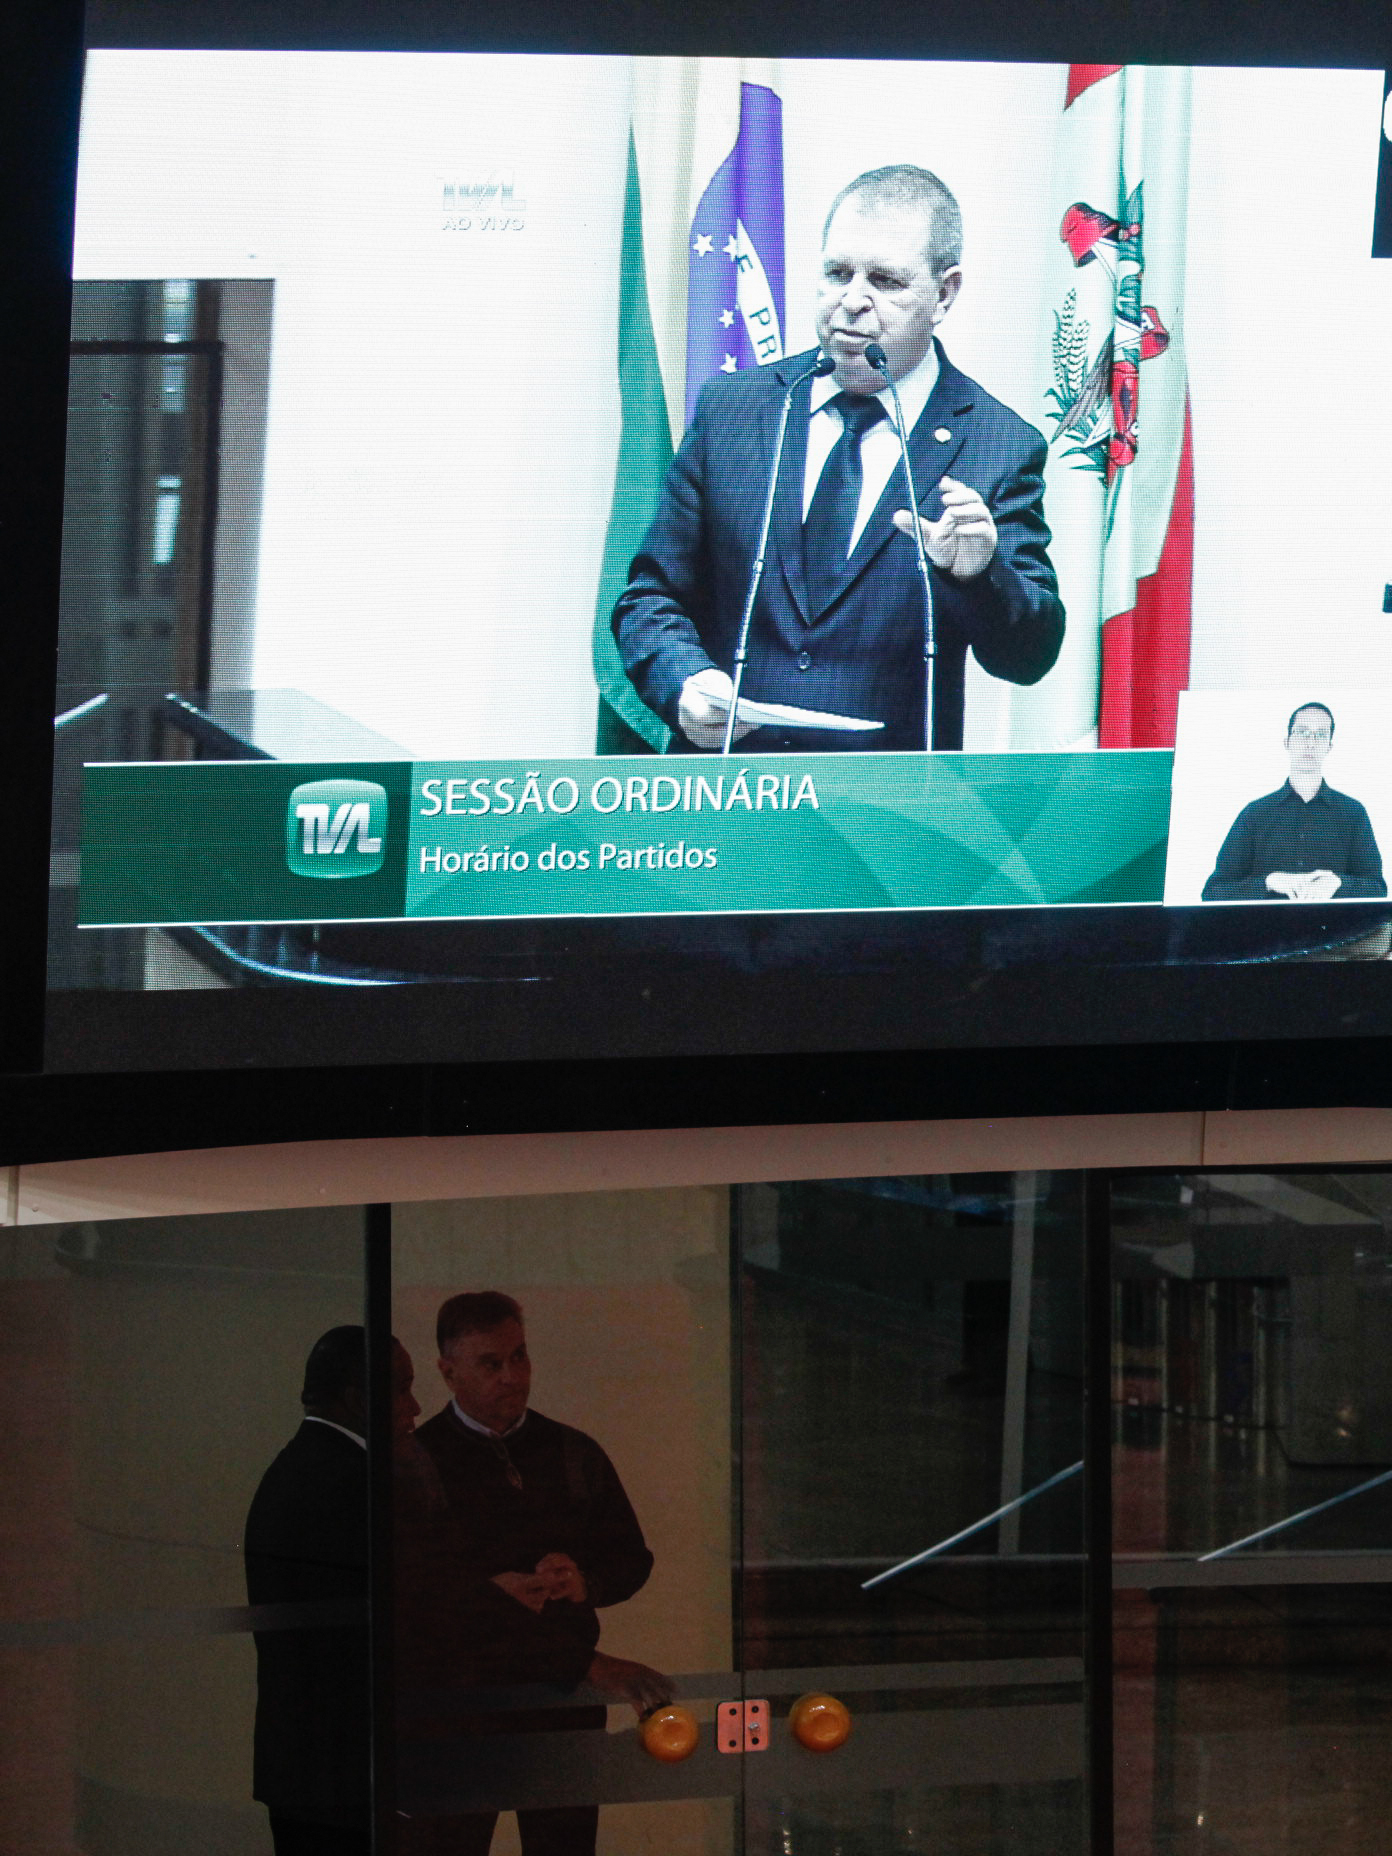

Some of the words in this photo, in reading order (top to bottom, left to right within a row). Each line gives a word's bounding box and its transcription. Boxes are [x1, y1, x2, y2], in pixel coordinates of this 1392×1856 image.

[442, 217, 471, 231] AO
[480, 216, 525, 231] VIVO
[420, 771, 580, 816] SESSÃO
[591, 769, 820, 814] ORDINÁRIA
[419, 845, 530, 873] Horário
[537, 842, 591, 871] dos
[599, 841, 718, 870] Partidos
